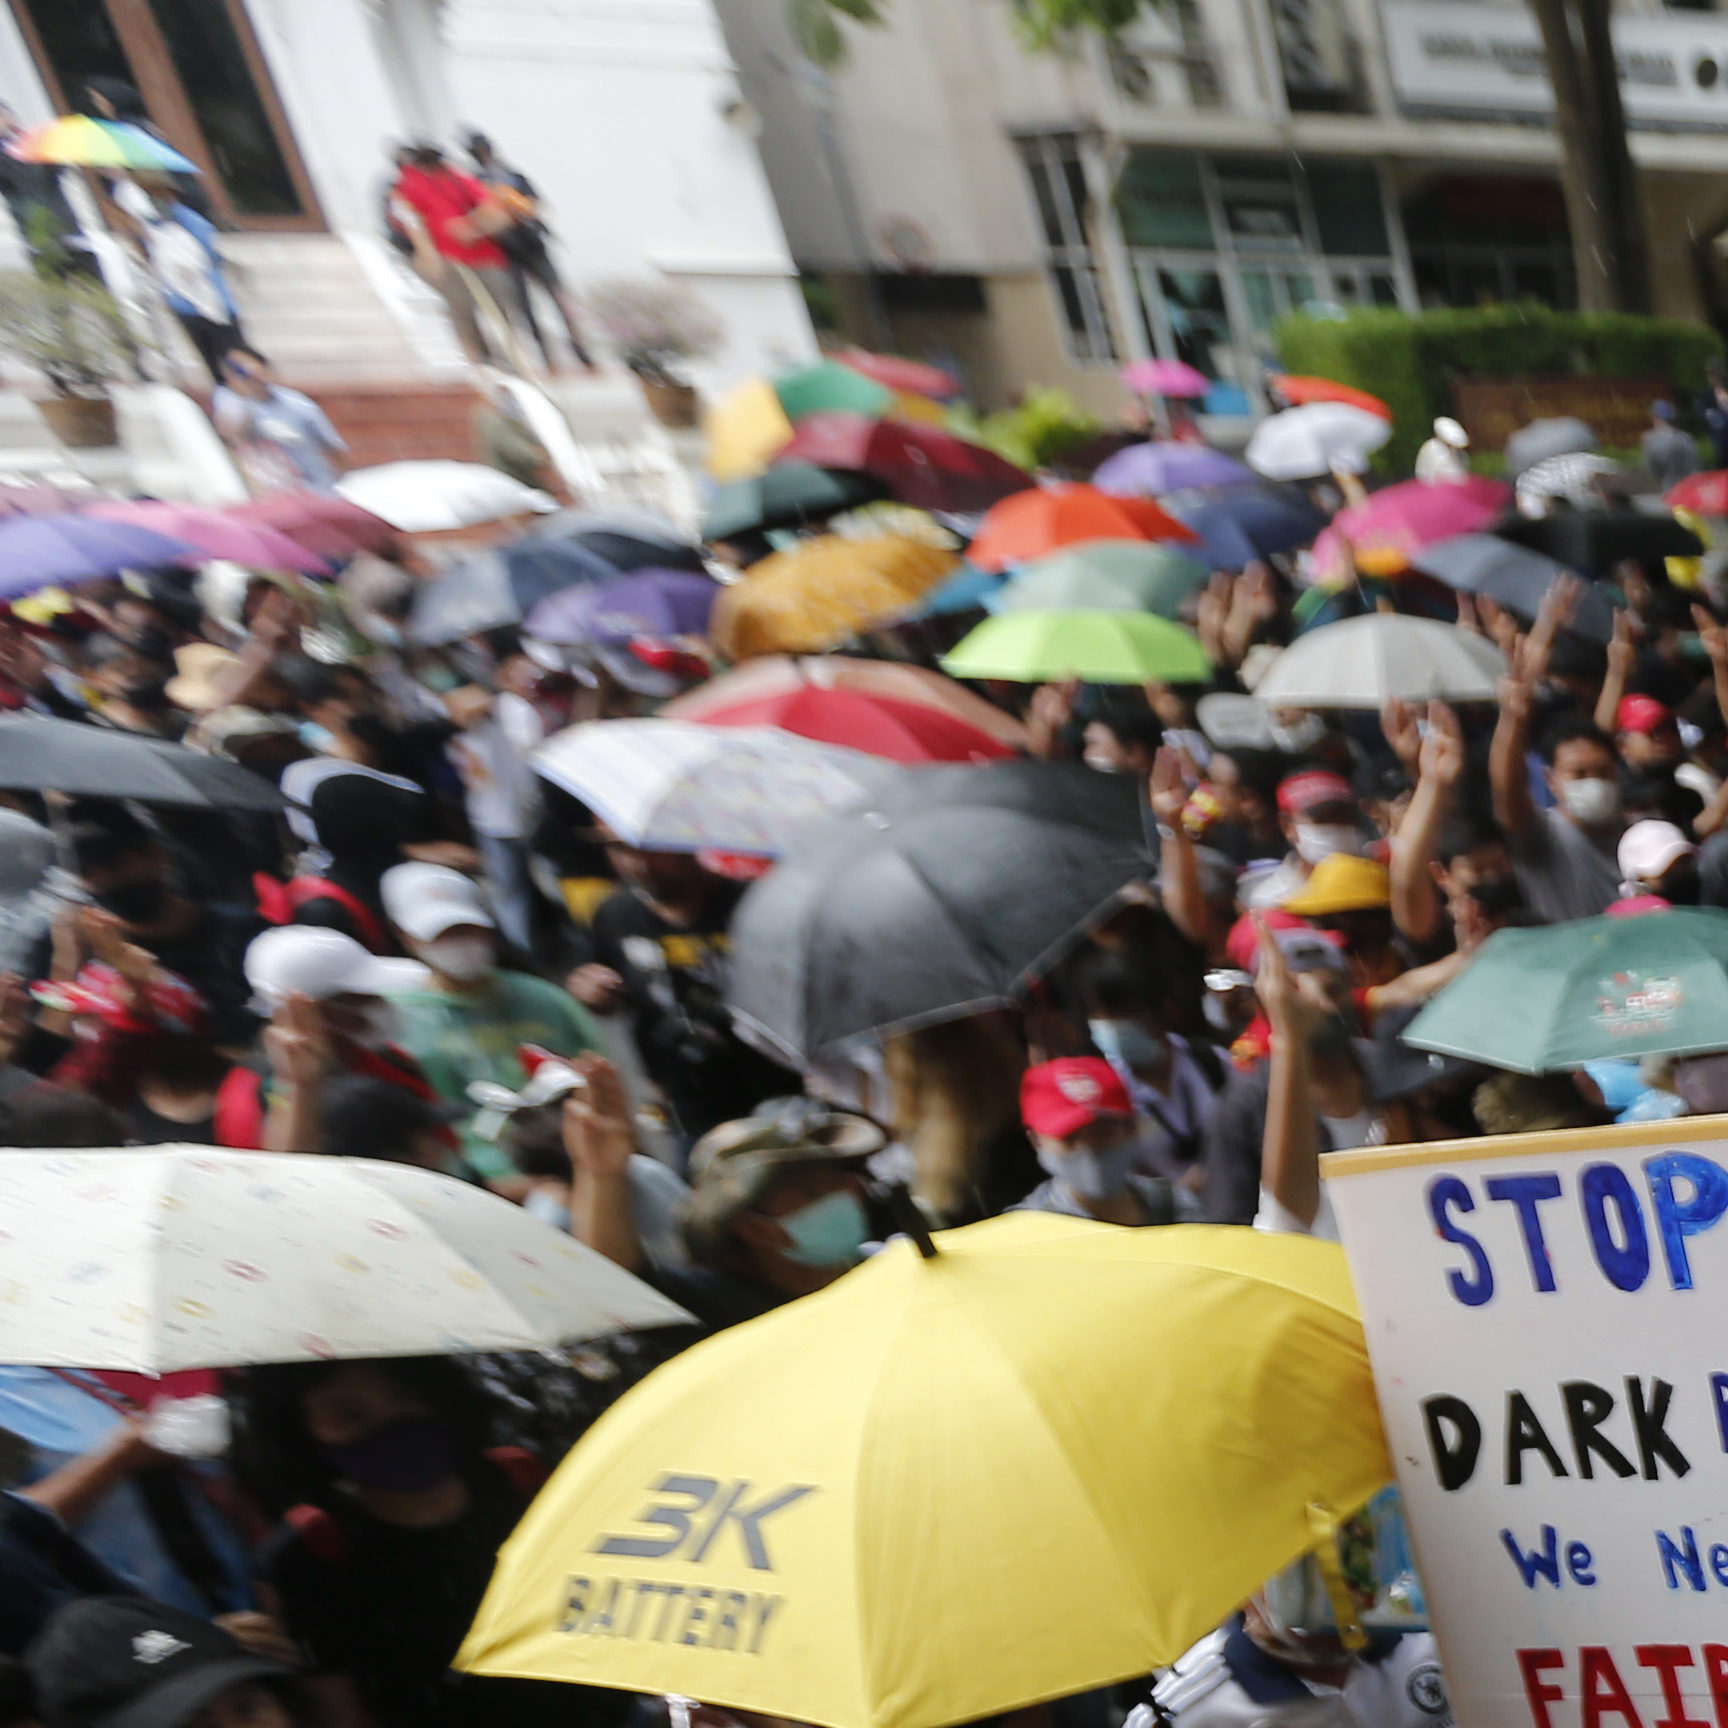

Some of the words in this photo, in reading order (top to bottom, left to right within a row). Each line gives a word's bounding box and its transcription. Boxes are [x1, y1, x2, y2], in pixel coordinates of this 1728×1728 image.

[1421, 1373, 1692, 1492] DARK
[586, 1469, 820, 1572] 3K
[1501, 1523, 1596, 1589] We
[555, 1573, 786, 1654] BATTERY
